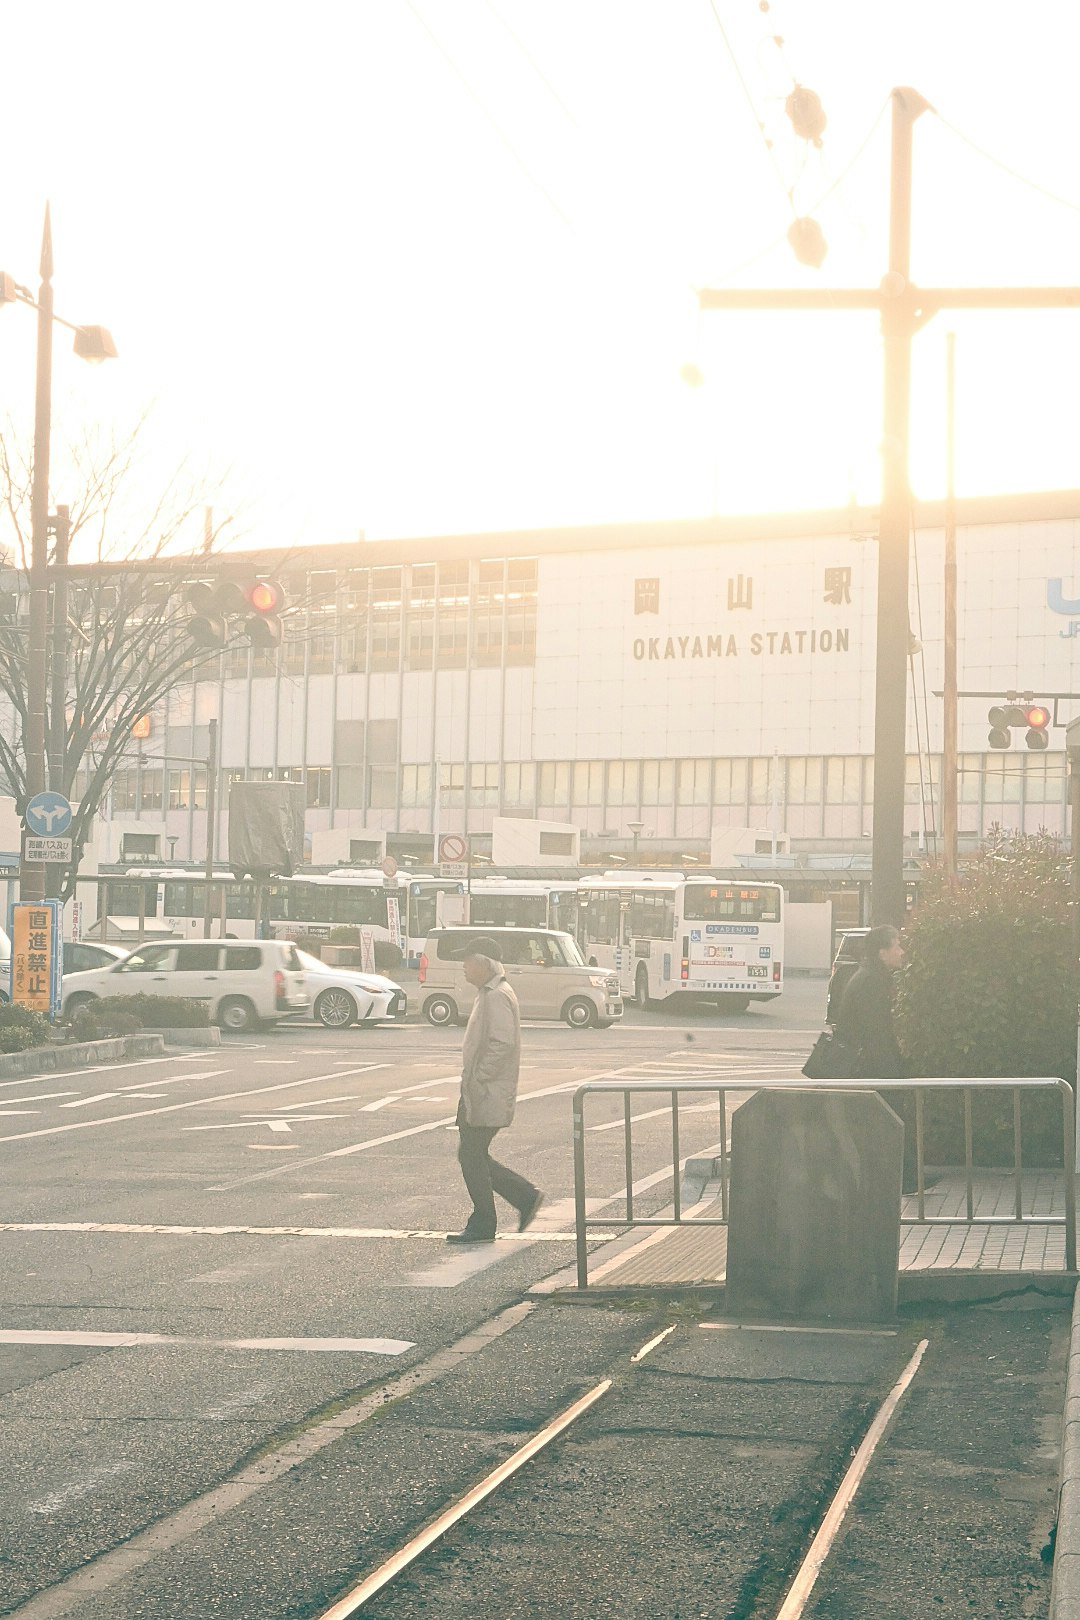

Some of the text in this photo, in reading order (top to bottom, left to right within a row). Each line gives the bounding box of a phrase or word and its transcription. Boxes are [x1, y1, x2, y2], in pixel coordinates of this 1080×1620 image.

[634, 566, 852, 615] 岡山駅
[633, 628, 849, 660] OKAYAMA STATION
[27, 910, 48, 995] 直進禁止
